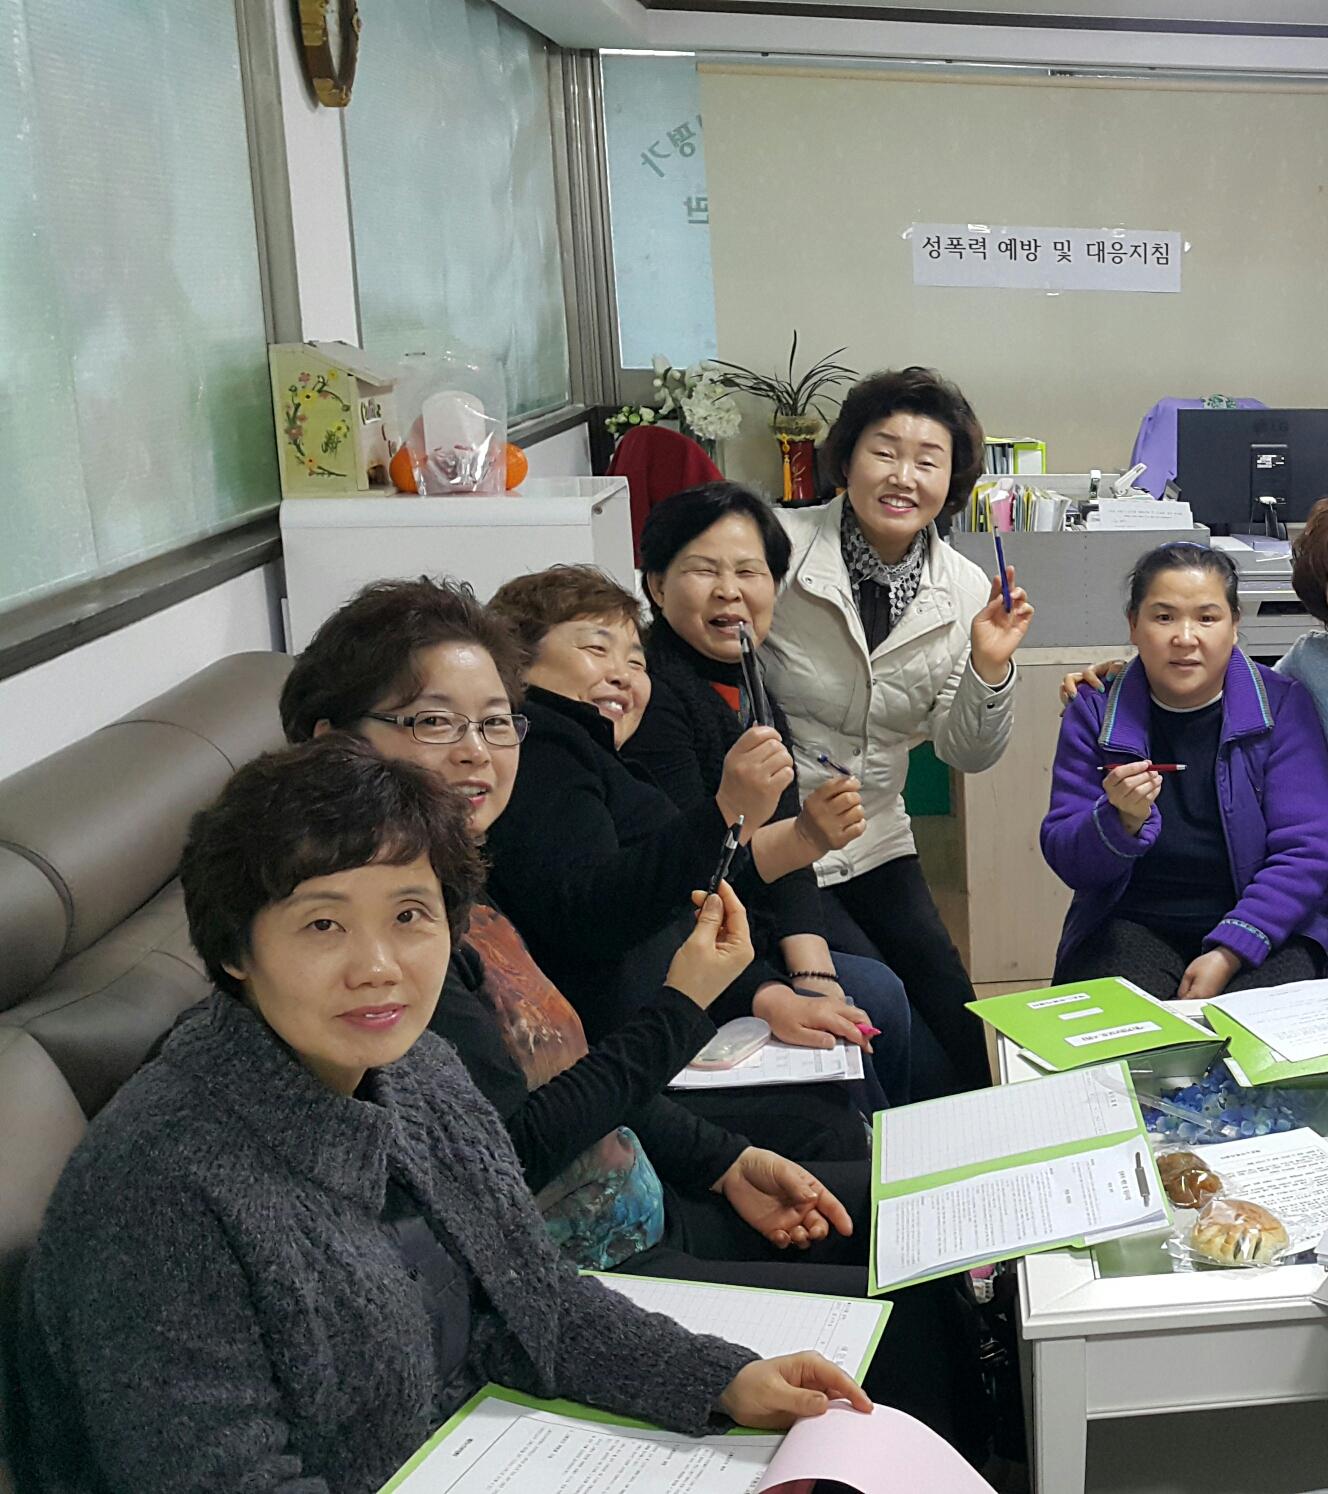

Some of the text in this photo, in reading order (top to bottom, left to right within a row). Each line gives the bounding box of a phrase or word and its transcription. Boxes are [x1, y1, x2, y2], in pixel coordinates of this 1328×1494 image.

[922, 235, 1170, 266] 성폭력 예방 및 대응지침
